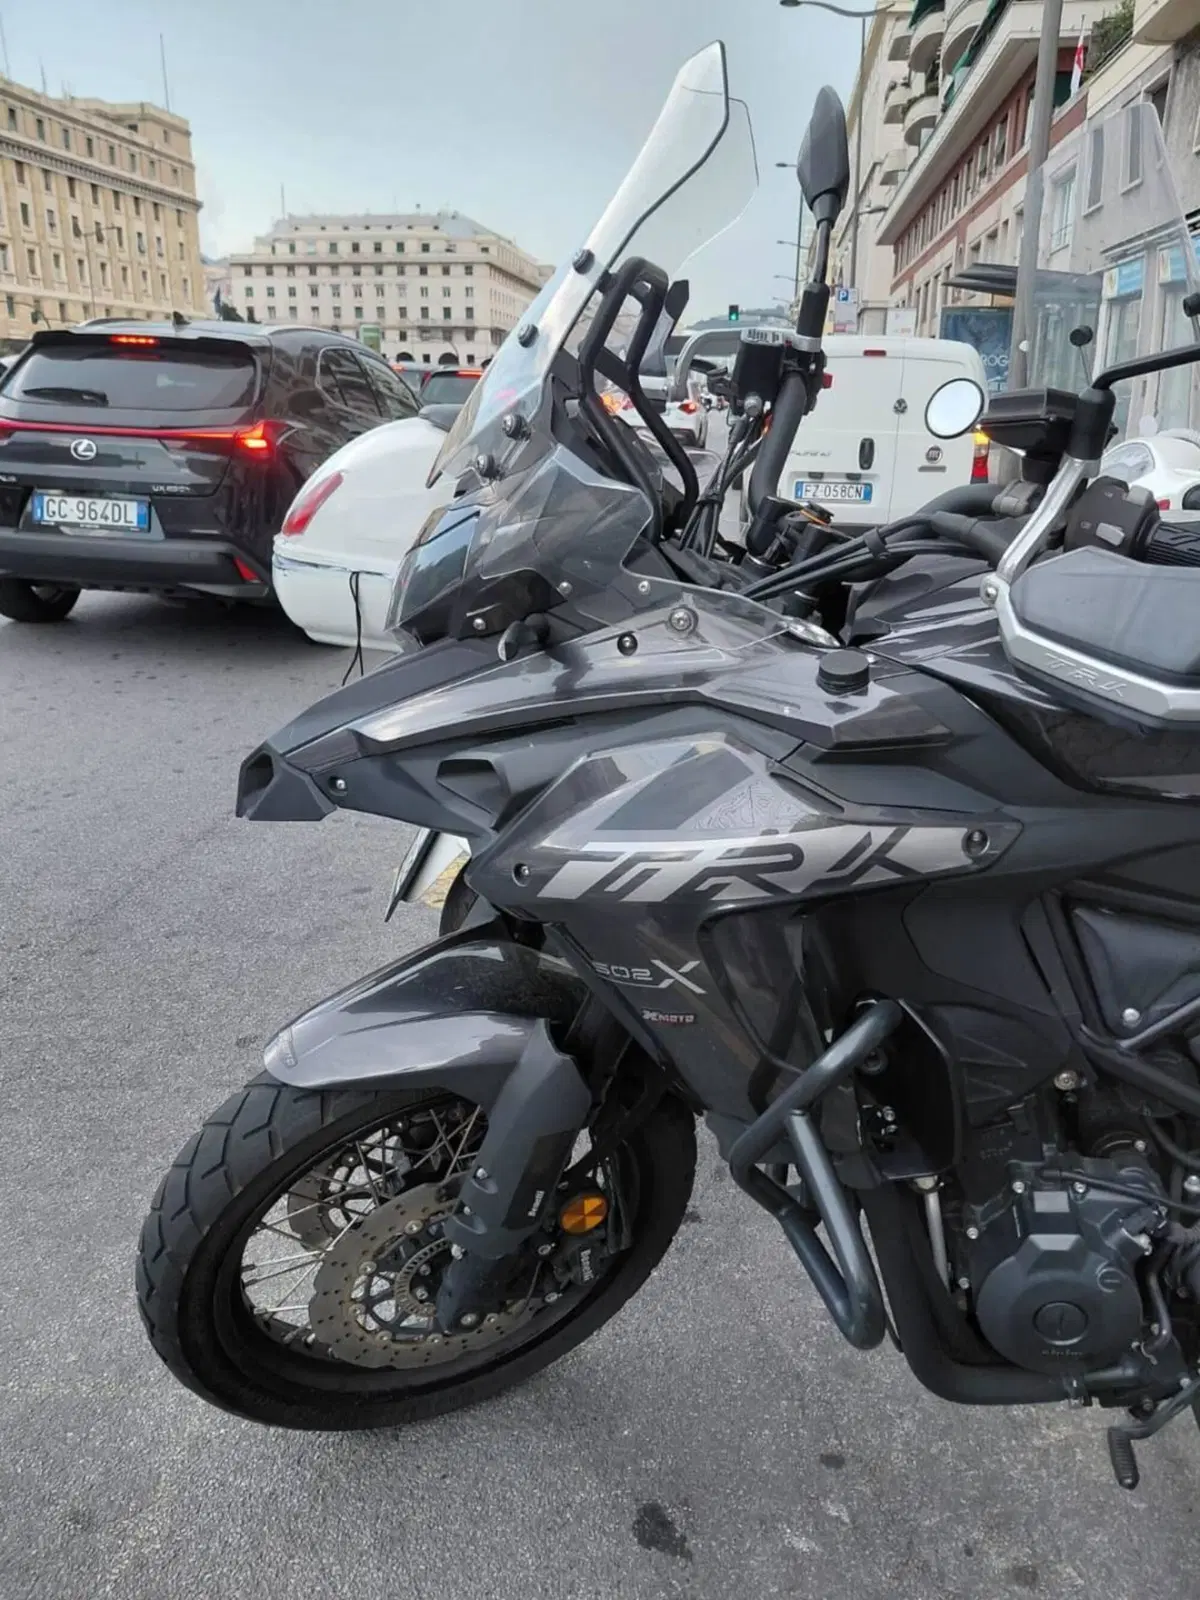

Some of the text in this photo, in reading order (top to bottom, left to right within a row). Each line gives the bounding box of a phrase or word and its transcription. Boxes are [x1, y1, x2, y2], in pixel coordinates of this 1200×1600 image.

[804, 484, 863, 499] FZ 058CN
[46, 498, 134, 524] GC 964DL
[555, 824, 940, 901] TRK
